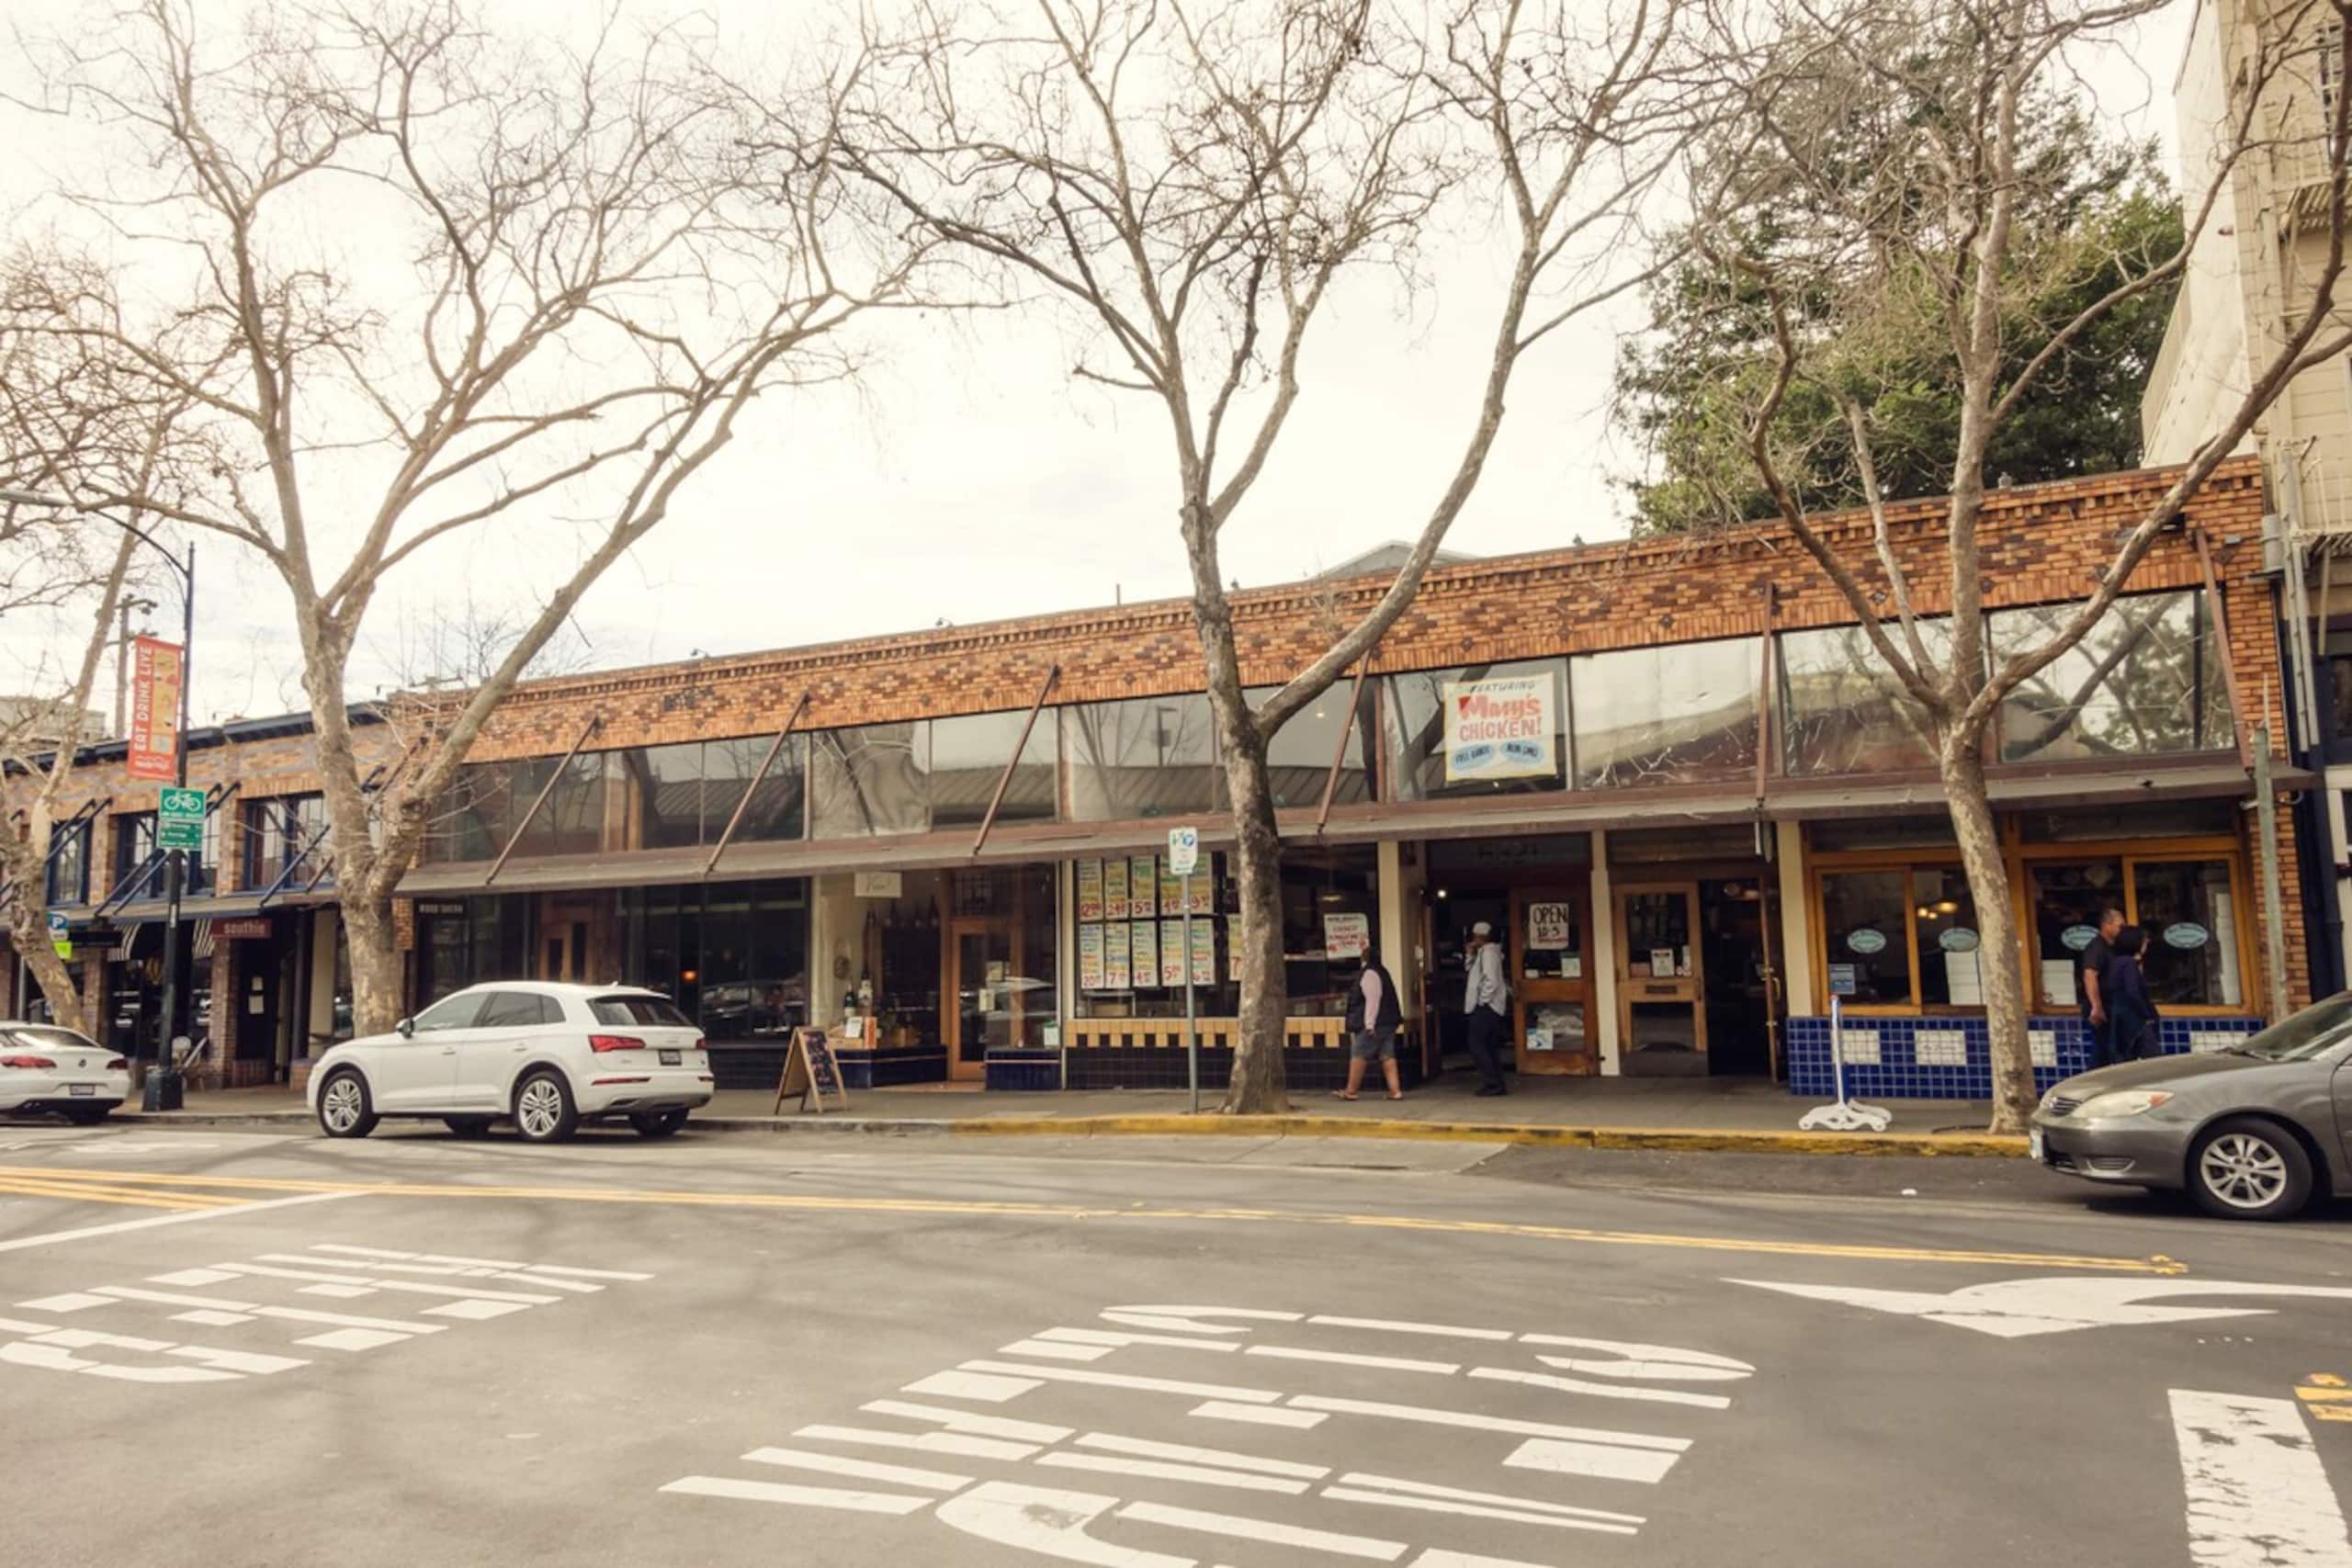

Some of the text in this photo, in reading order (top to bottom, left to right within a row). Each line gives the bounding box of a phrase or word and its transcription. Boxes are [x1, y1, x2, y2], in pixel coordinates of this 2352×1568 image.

[134, 646, 153, 750] EAT DRINK LIVE
[1470, 680, 1535, 693] FEATURING
[1458, 694, 1542, 720] Mary's
[1459, 716, 1542, 742] CHICKEN!
[1534, 906, 1566, 924] OPEN
